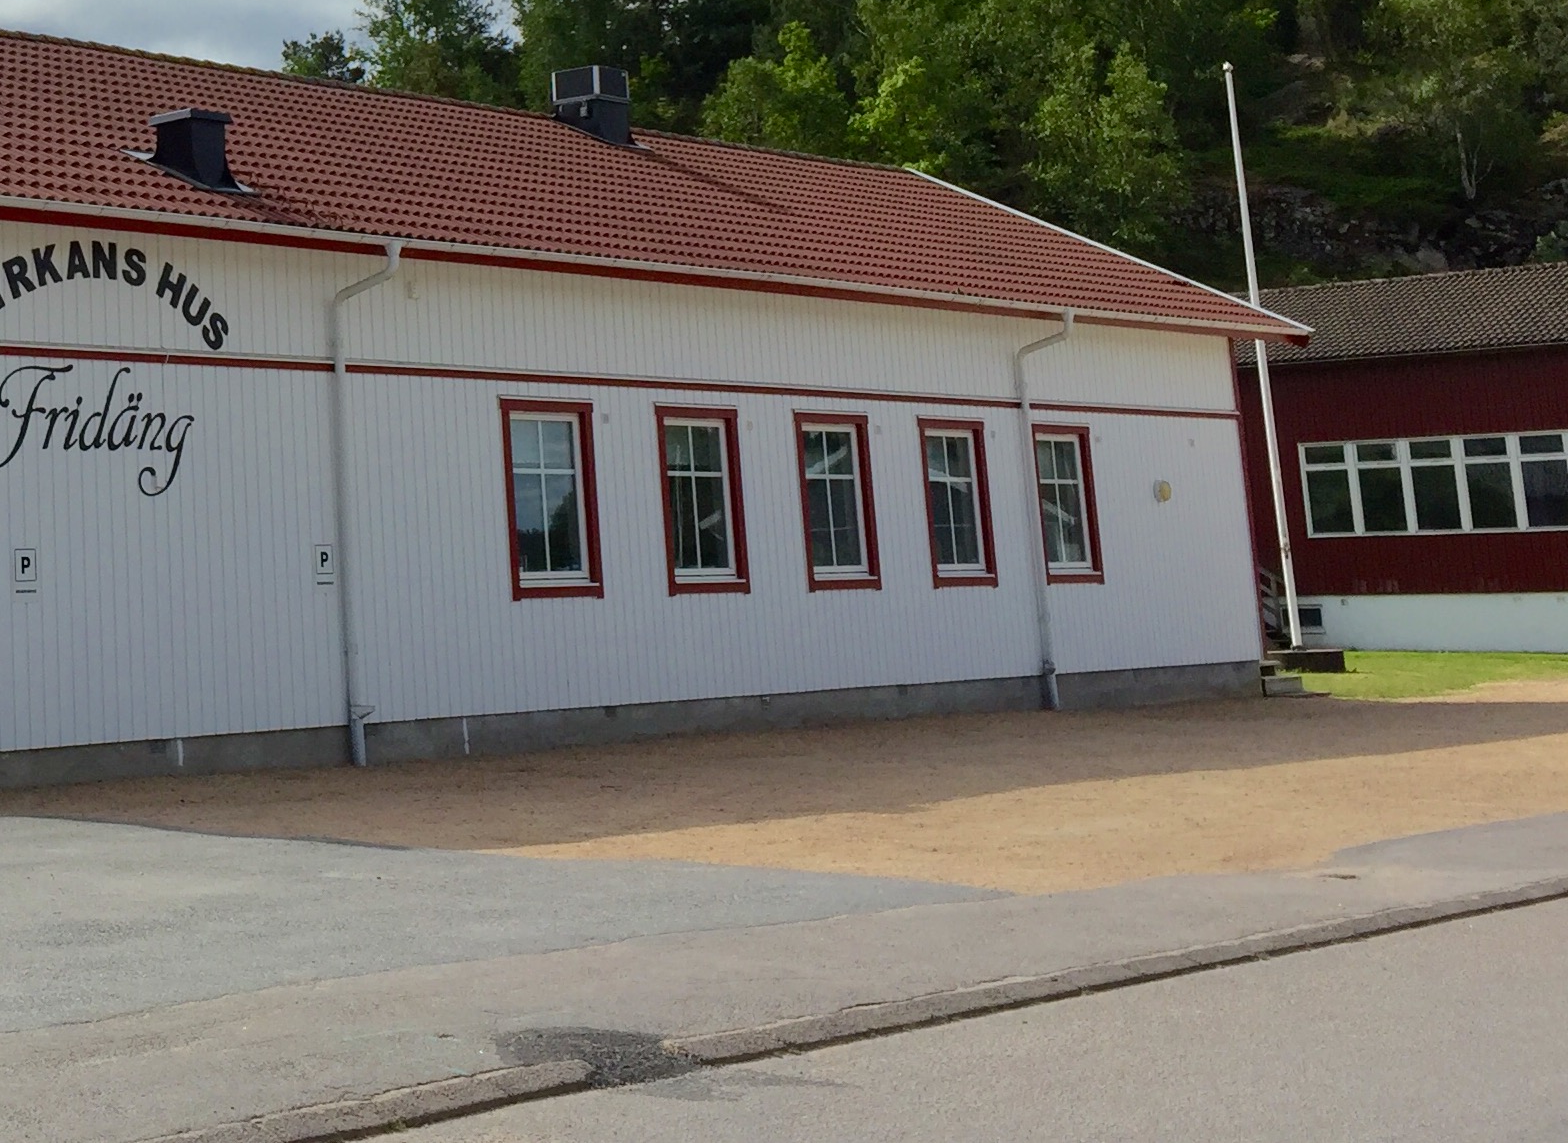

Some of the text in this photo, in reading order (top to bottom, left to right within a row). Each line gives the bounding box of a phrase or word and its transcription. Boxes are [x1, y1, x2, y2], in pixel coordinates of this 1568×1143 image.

[156, 262, 229, 350] HUS
[21, 556, 31, 574] P
[321, 551, 329, 567] P
